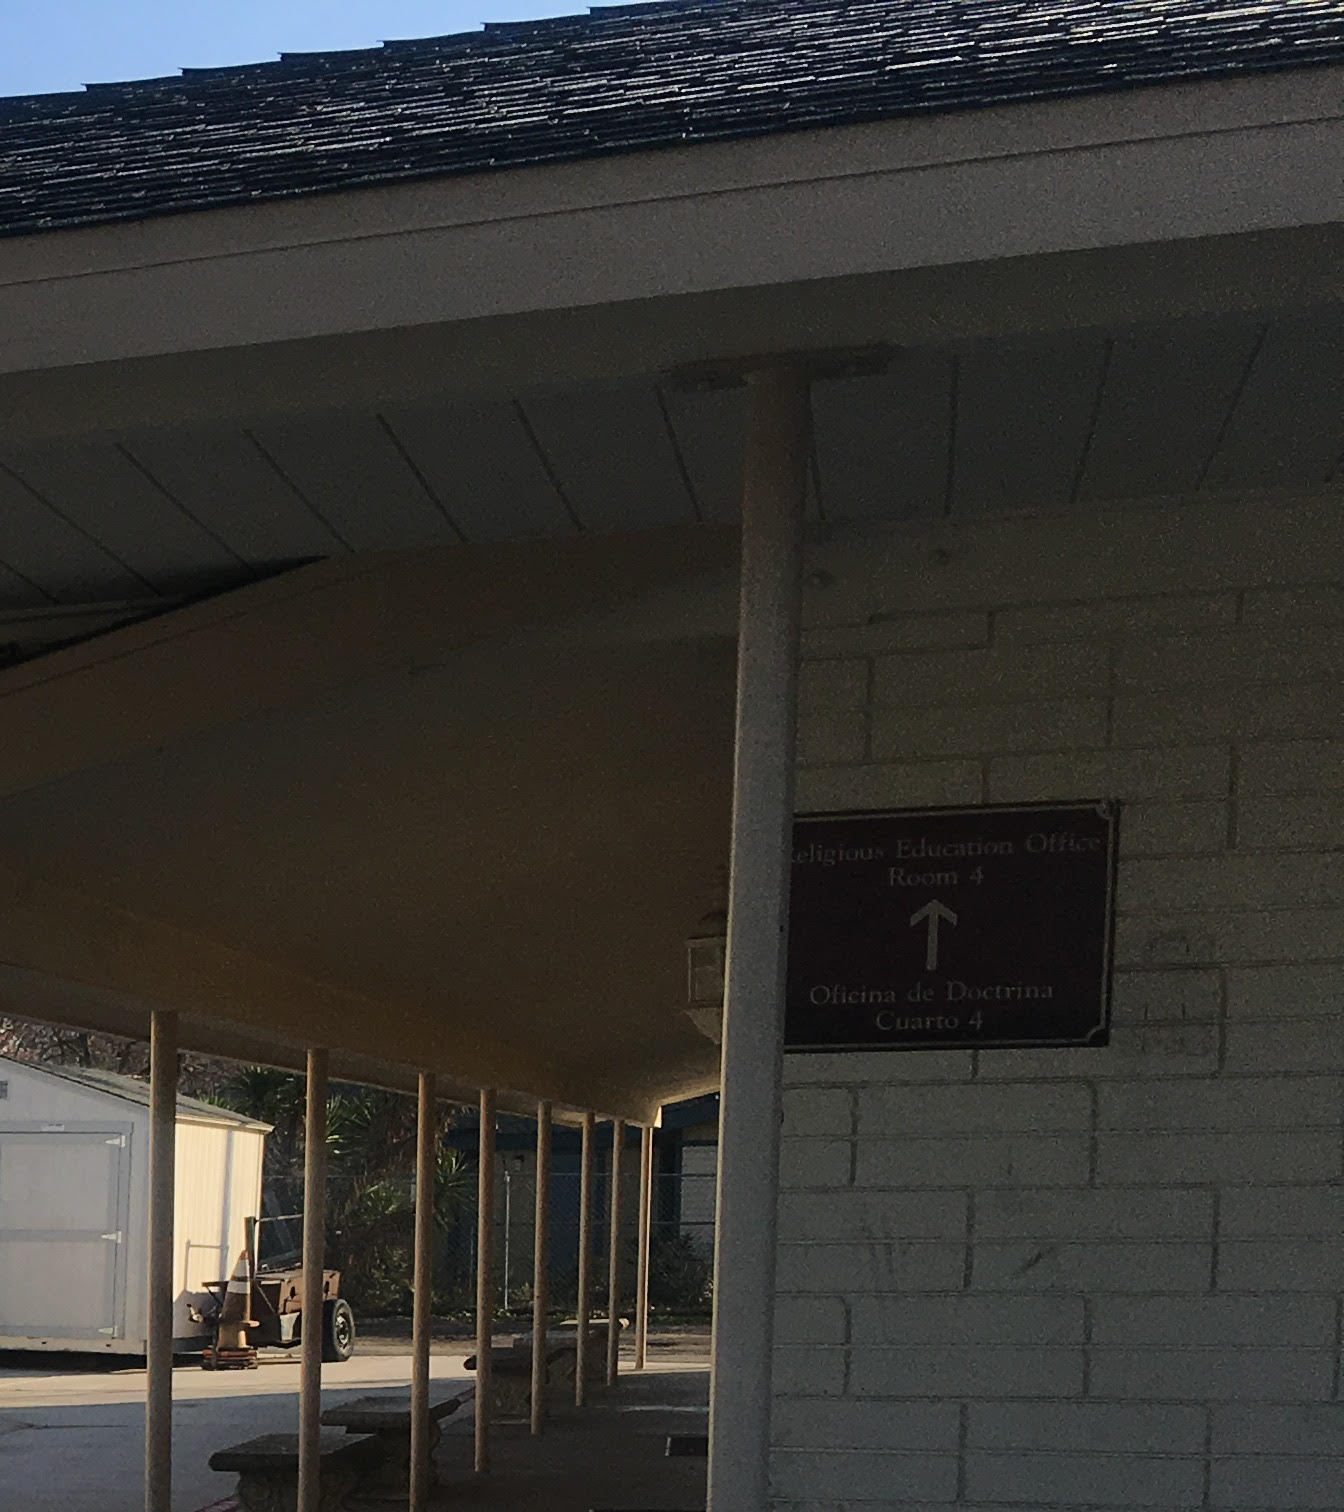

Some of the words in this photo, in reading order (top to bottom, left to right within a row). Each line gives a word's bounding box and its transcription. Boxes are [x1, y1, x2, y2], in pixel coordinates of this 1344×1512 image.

[792, 843, 887, 867] eligious
[895, 836, 1014, 860] Education
[1025, 832, 1101, 853] Office
[888, 866, 958, 888] Room
[968, 865, 985, 886] 4
[809, 983, 896, 1005] Oficina
[907, 982, 935, 1002] de
[945, 980, 1054, 1001] Doctrina
[875, 1012, 960, 1032] Cuarto
[968, 1010, 984, 1031] 4
